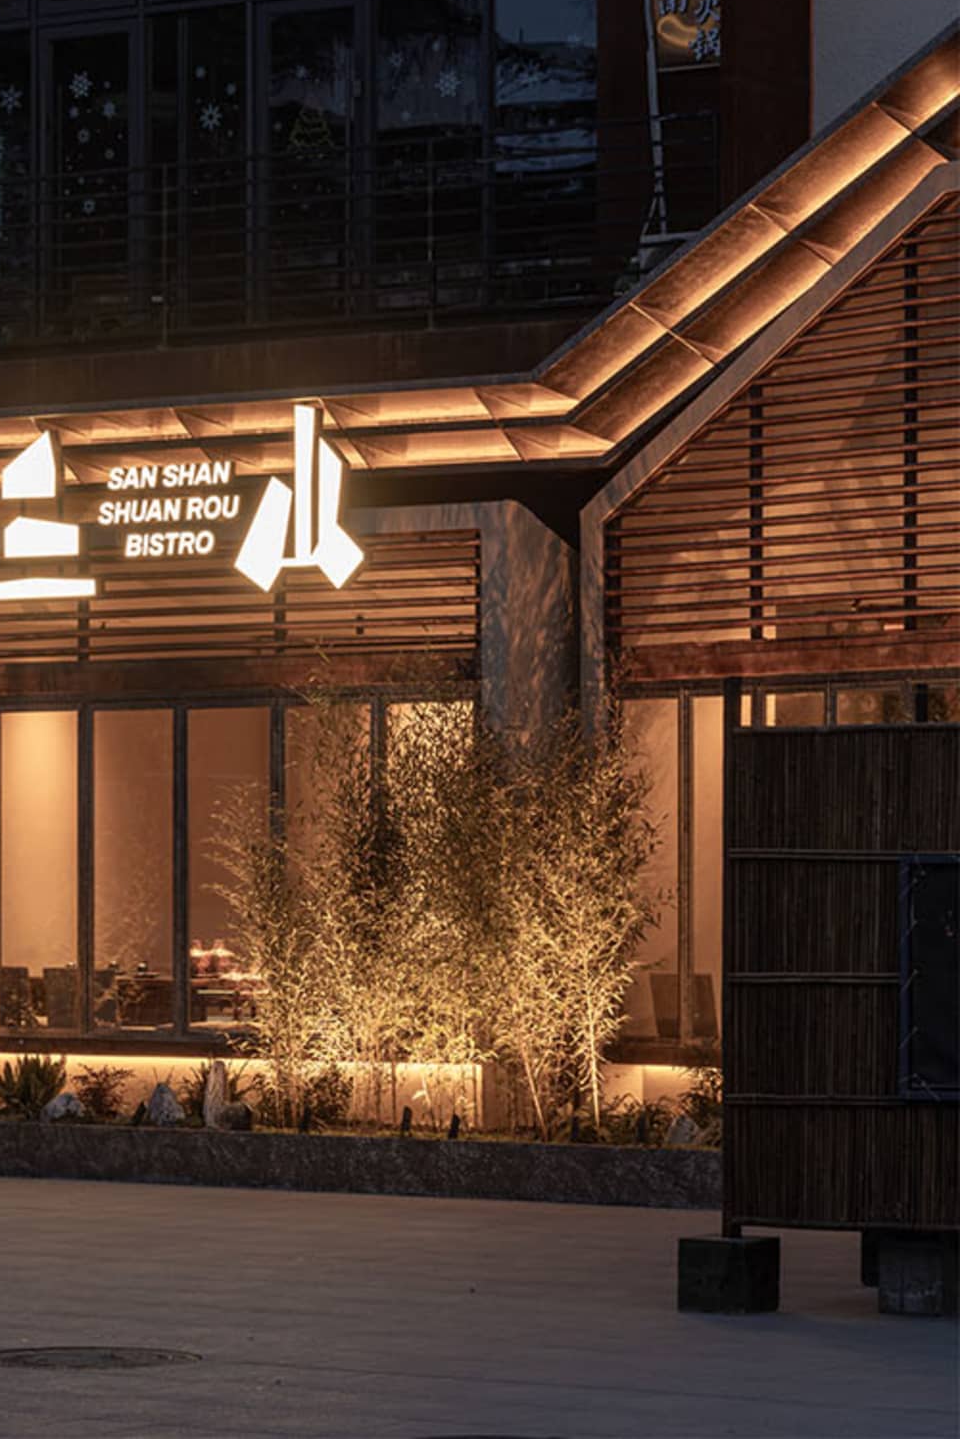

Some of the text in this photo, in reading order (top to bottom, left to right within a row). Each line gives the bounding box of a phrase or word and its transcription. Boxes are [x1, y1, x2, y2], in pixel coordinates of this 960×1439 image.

[106, 460, 232, 492] SAN SHAN
[97, 494, 241, 526] SHUAN ROU
[124, 530, 216, 559] BISTRO
